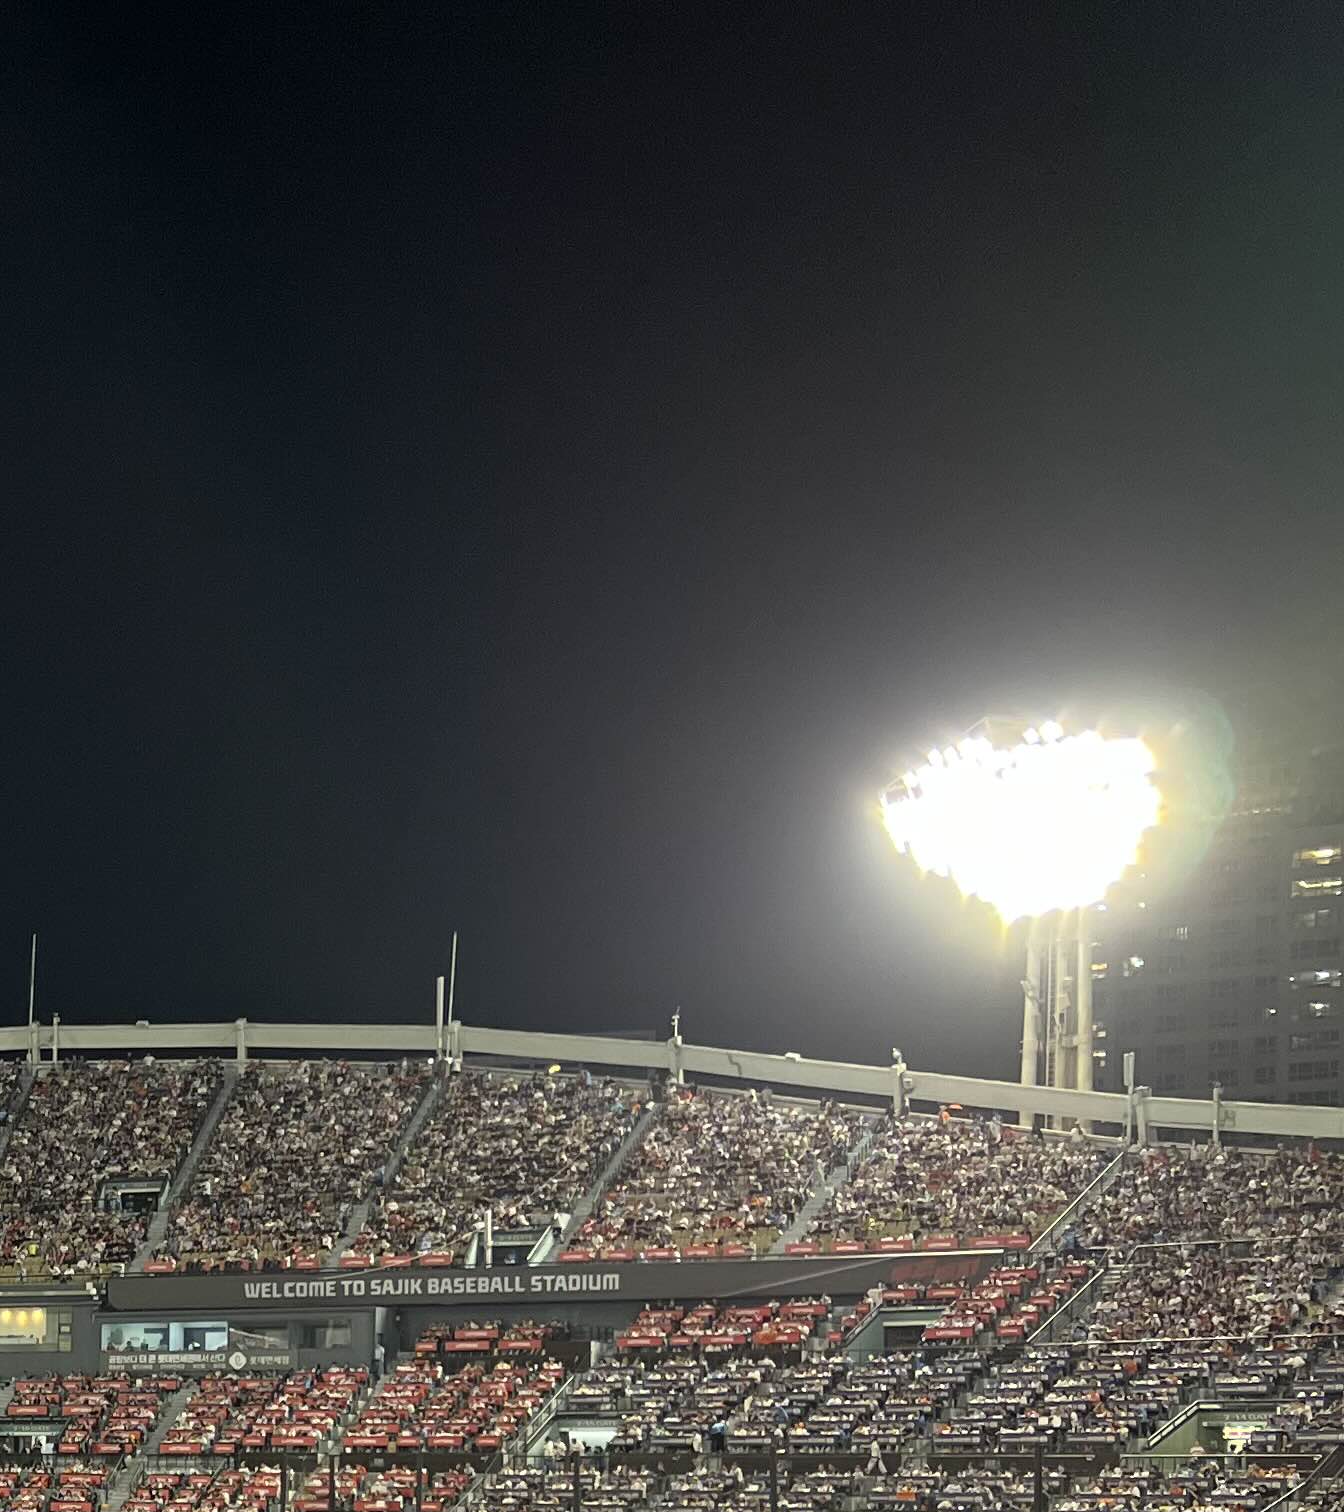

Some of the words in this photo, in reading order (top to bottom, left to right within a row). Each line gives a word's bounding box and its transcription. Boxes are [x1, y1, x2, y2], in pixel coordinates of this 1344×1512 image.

[244, 1280, 336, 1298] WELCOME
[340, 1280, 365, 1296] TO
[370, 1278, 423, 1295] SAJIK
[427, 1276, 525, 1294] BASEBALL
[530, 1273, 620, 1292] STADIUM
